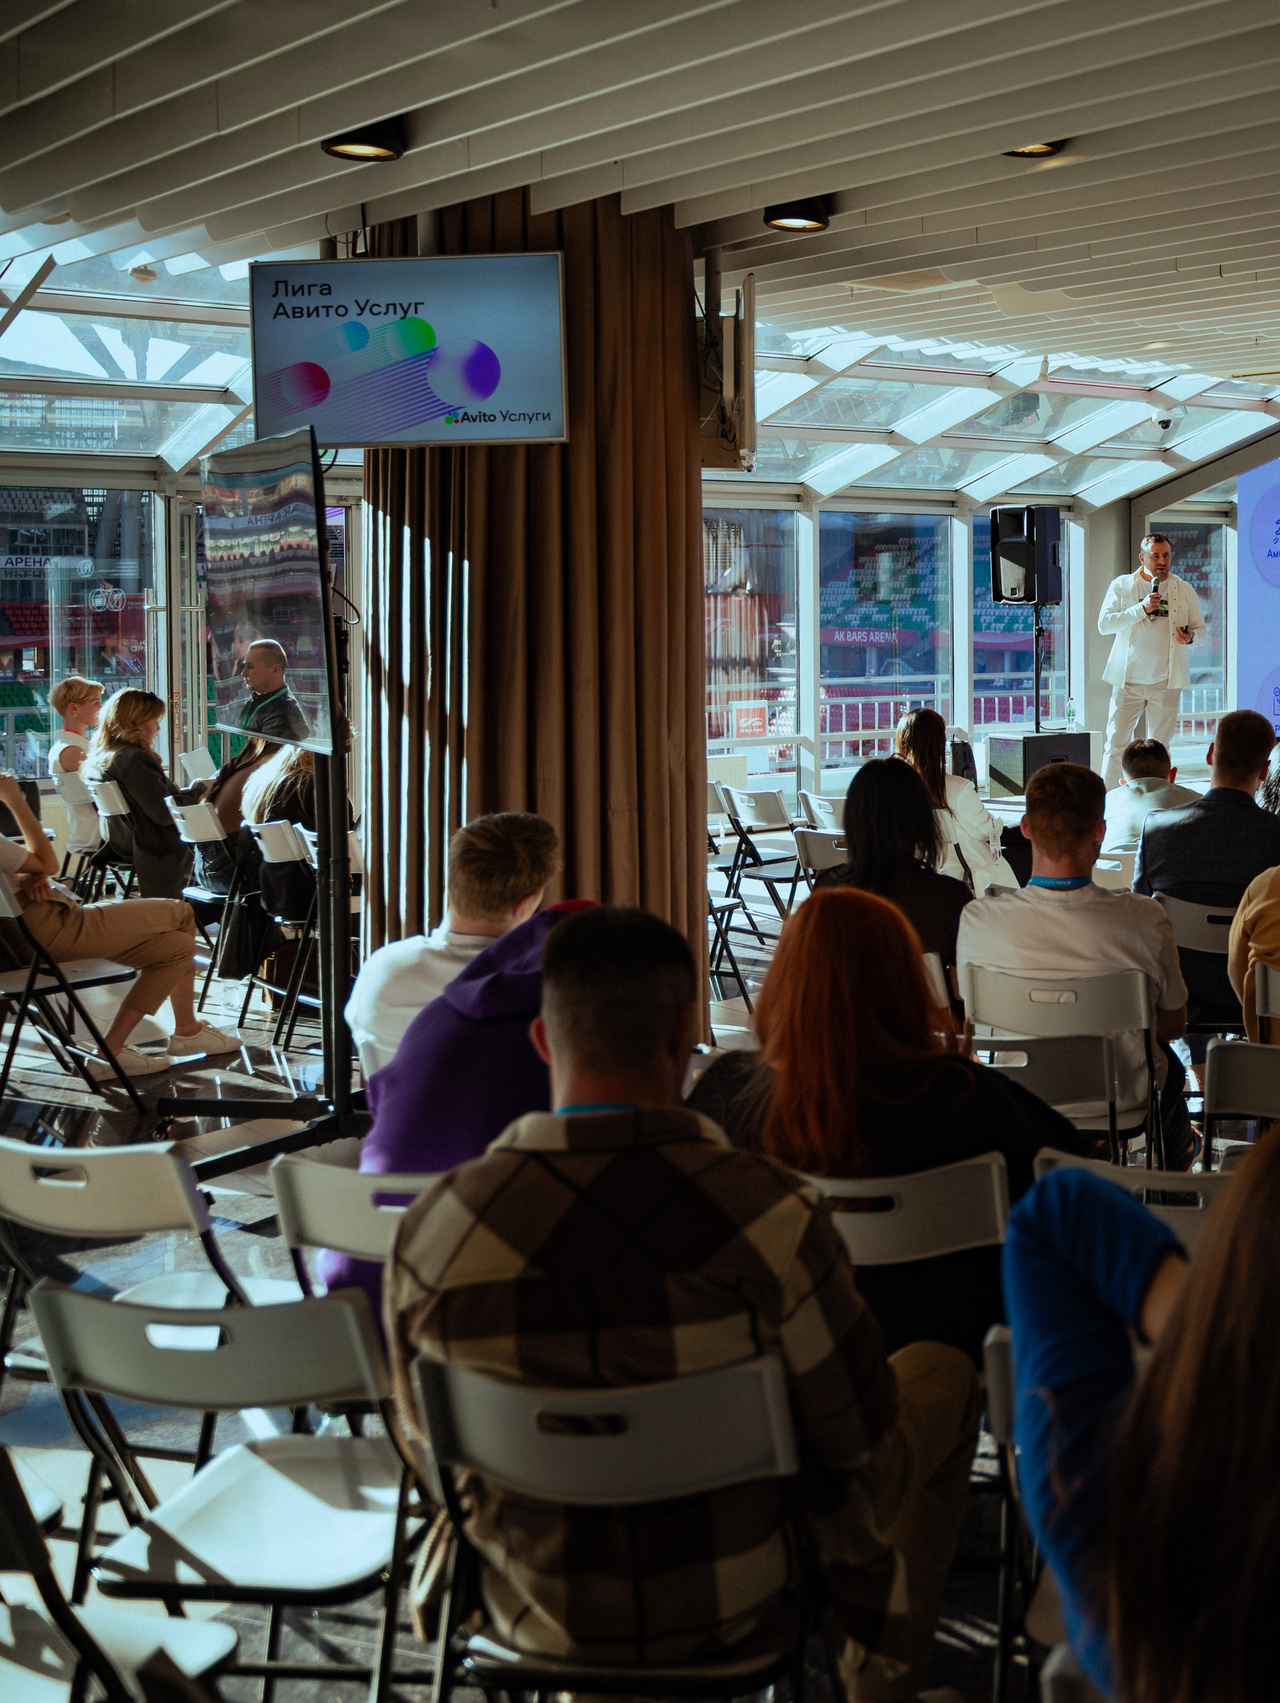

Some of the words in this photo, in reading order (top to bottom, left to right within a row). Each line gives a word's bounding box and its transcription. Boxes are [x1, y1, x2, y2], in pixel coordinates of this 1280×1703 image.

[271, 279, 332, 298] Лига
[272, 301, 349, 319] Авито
[354, 299, 425, 320] Услуг
[460, 410, 497, 424] Avito
[499, 409, 551, 425] Услуги
[4, 556, 52, 567] АРЕНА
[834, 630, 845, 642] AK
[846, 631, 867, 643] BARS
[868, 631, 898, 643] ARENA
